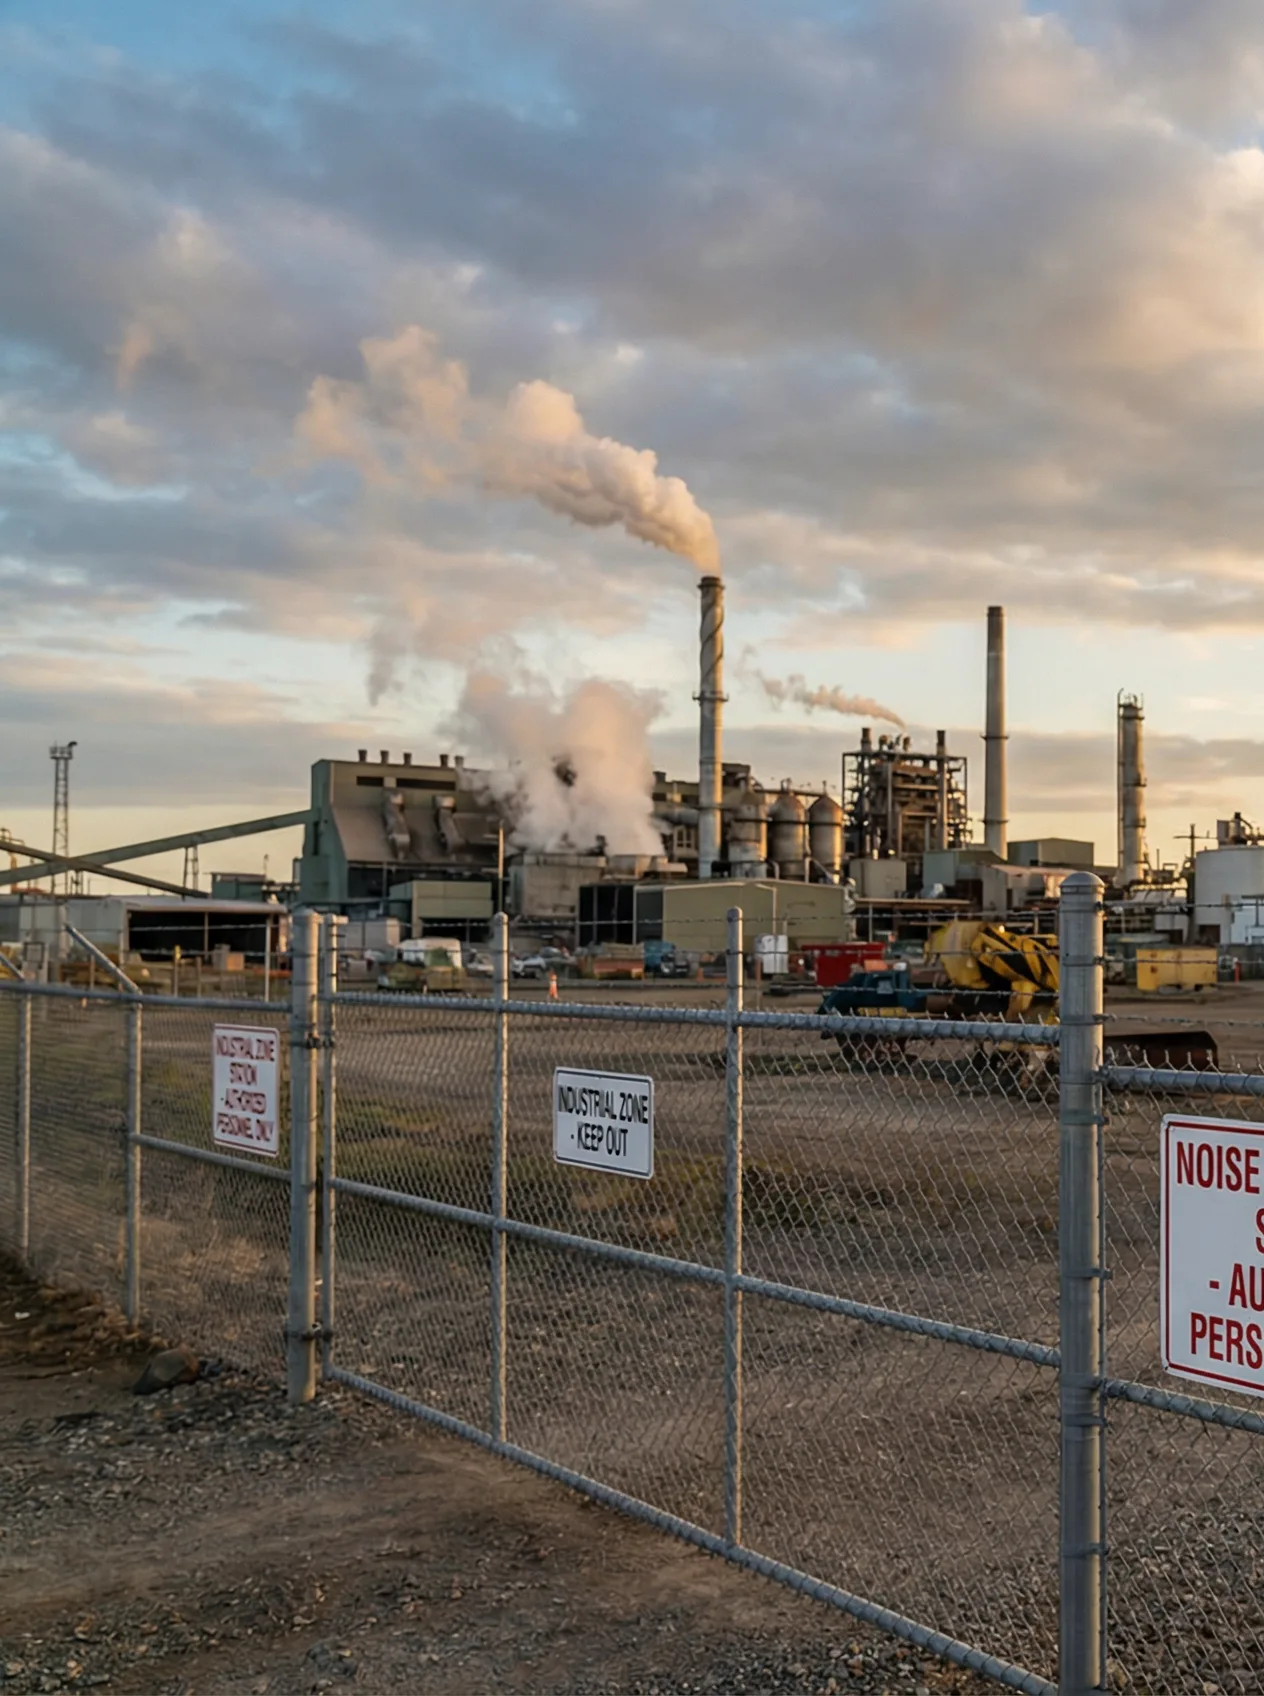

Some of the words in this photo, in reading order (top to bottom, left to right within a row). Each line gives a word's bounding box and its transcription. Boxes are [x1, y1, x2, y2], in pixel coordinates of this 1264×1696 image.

[558, 1085, 617, 1120] INDUSTRIAL
[619, 1092, 648, 1124] ZONE
[577, 1121, 604, 1151] KEEP
[606, 1125, 628, 1156] OUT
[1176, 1141, 1260, 1194] NOISE
[1209, 1280, 1219, 1290] -
